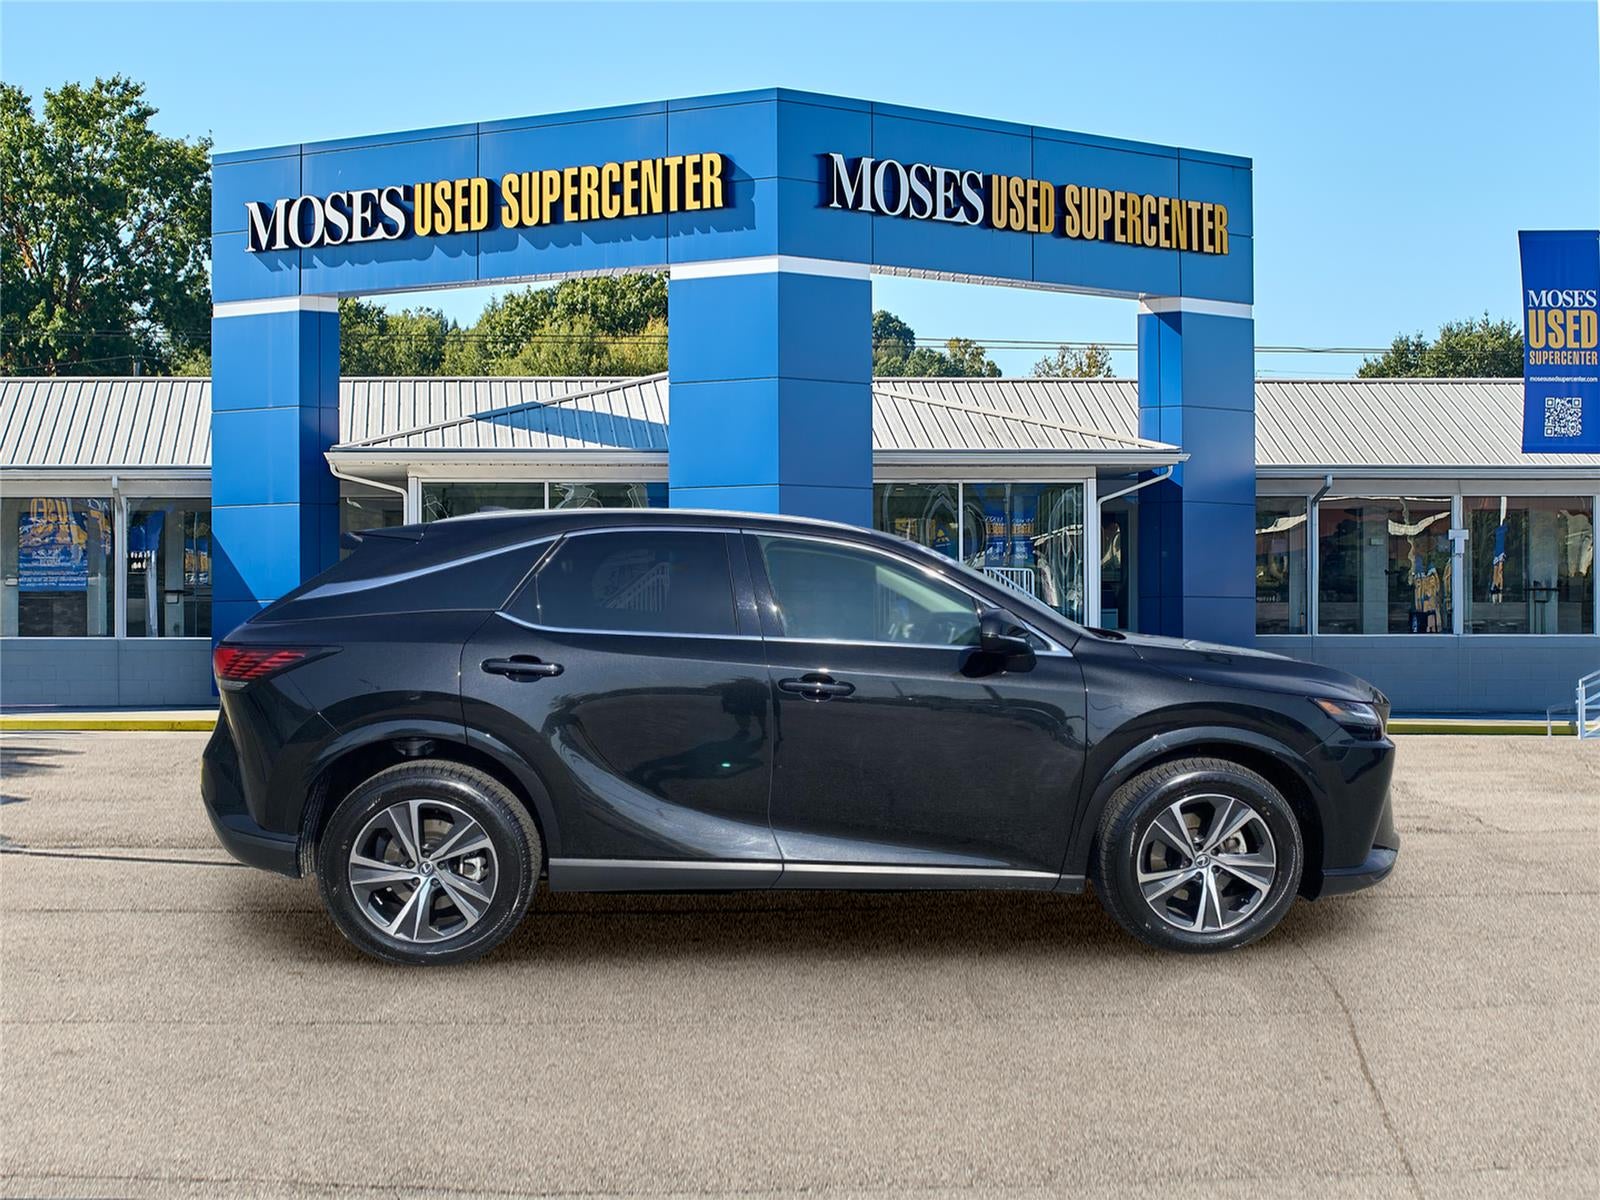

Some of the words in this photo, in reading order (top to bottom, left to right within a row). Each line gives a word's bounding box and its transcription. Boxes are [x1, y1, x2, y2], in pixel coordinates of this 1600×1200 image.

[244, 185, 406, 253] MOSES
[413, 177, 489, 238] USED
[500, 152, 724, 229] SUPERCENTER
[828, 152, 984, 226] MOSES
[991, 173, 1056, 234] USED
[1065, 183, 1229, 256] SUPERCENTER
[1528, 289, 1598, 308] MOSES
[1528, 309, 1598, 349] USED
[1529, 350, 1599, 366] SUPERCENTER
